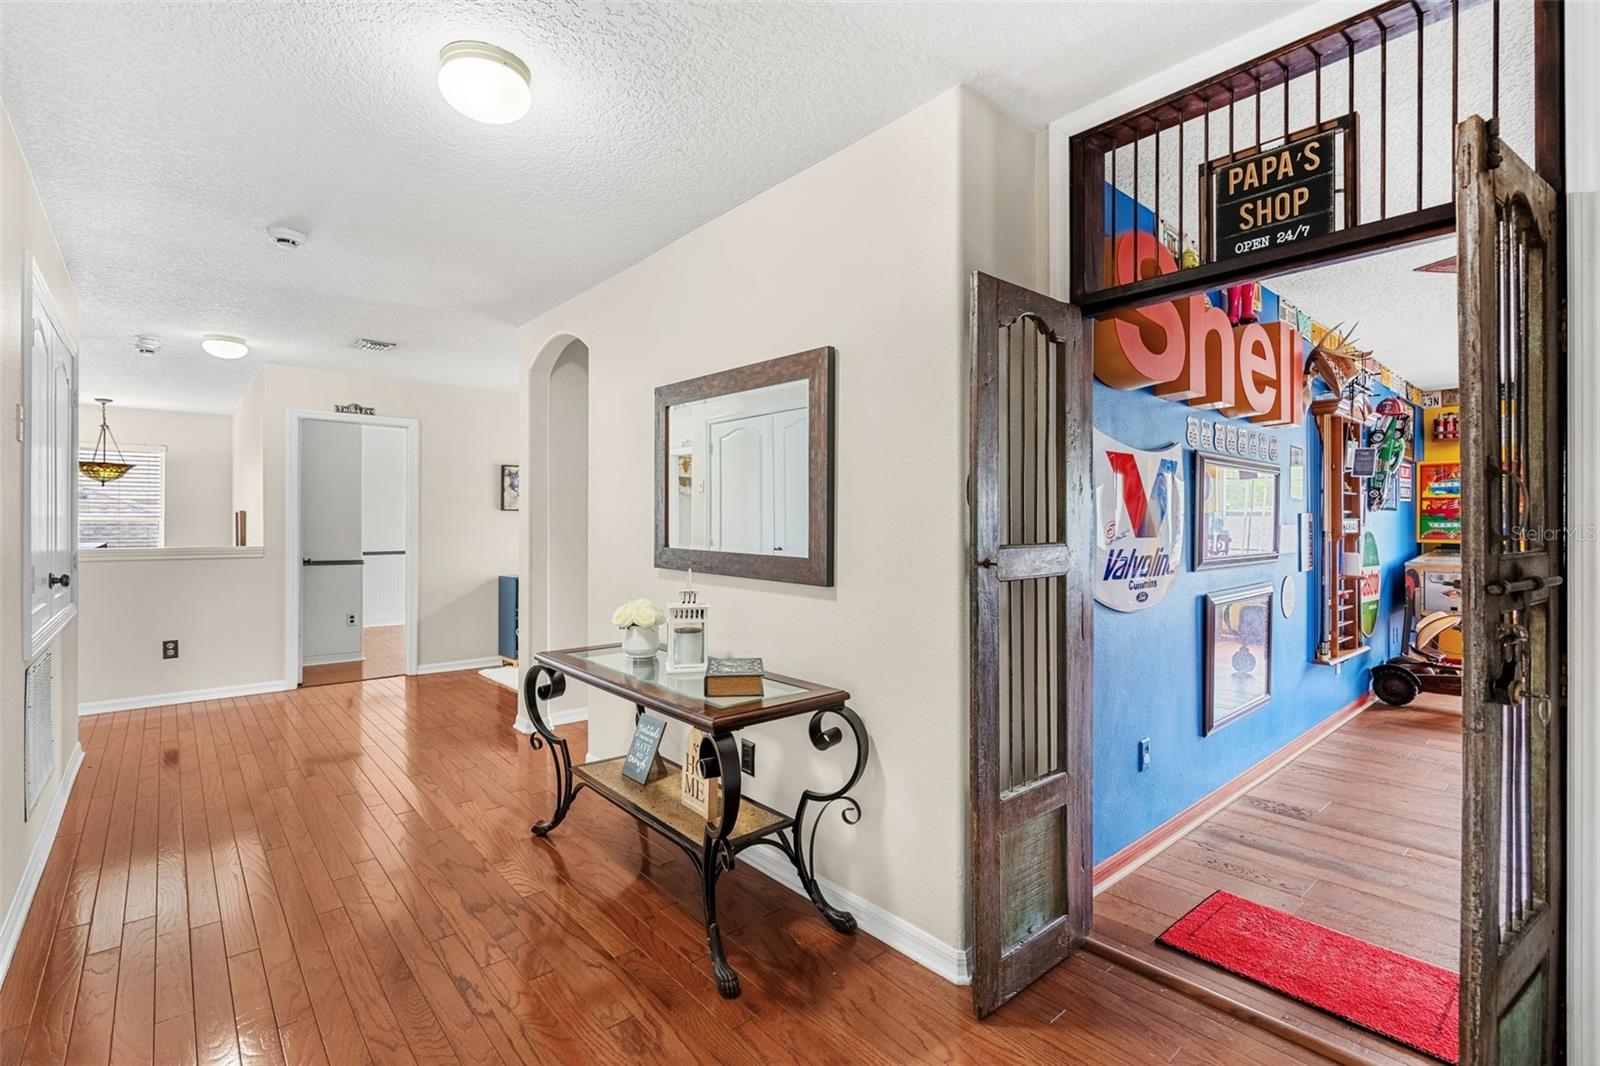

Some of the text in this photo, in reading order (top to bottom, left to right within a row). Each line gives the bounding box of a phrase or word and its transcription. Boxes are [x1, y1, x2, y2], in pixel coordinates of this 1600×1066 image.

[1229, 141, 1320, 195] PAPA'S
[1240, 186, 1309, 230] SHOP
[1235, 224, 1310, 254] OPEN 24/7
[1117, 230, 1303, 425] Shell
[1103, 547, 1175, 581] Valvolin
[1128, 579, 1157, 591] Cummins
[685, 773, 705, 803] ME
